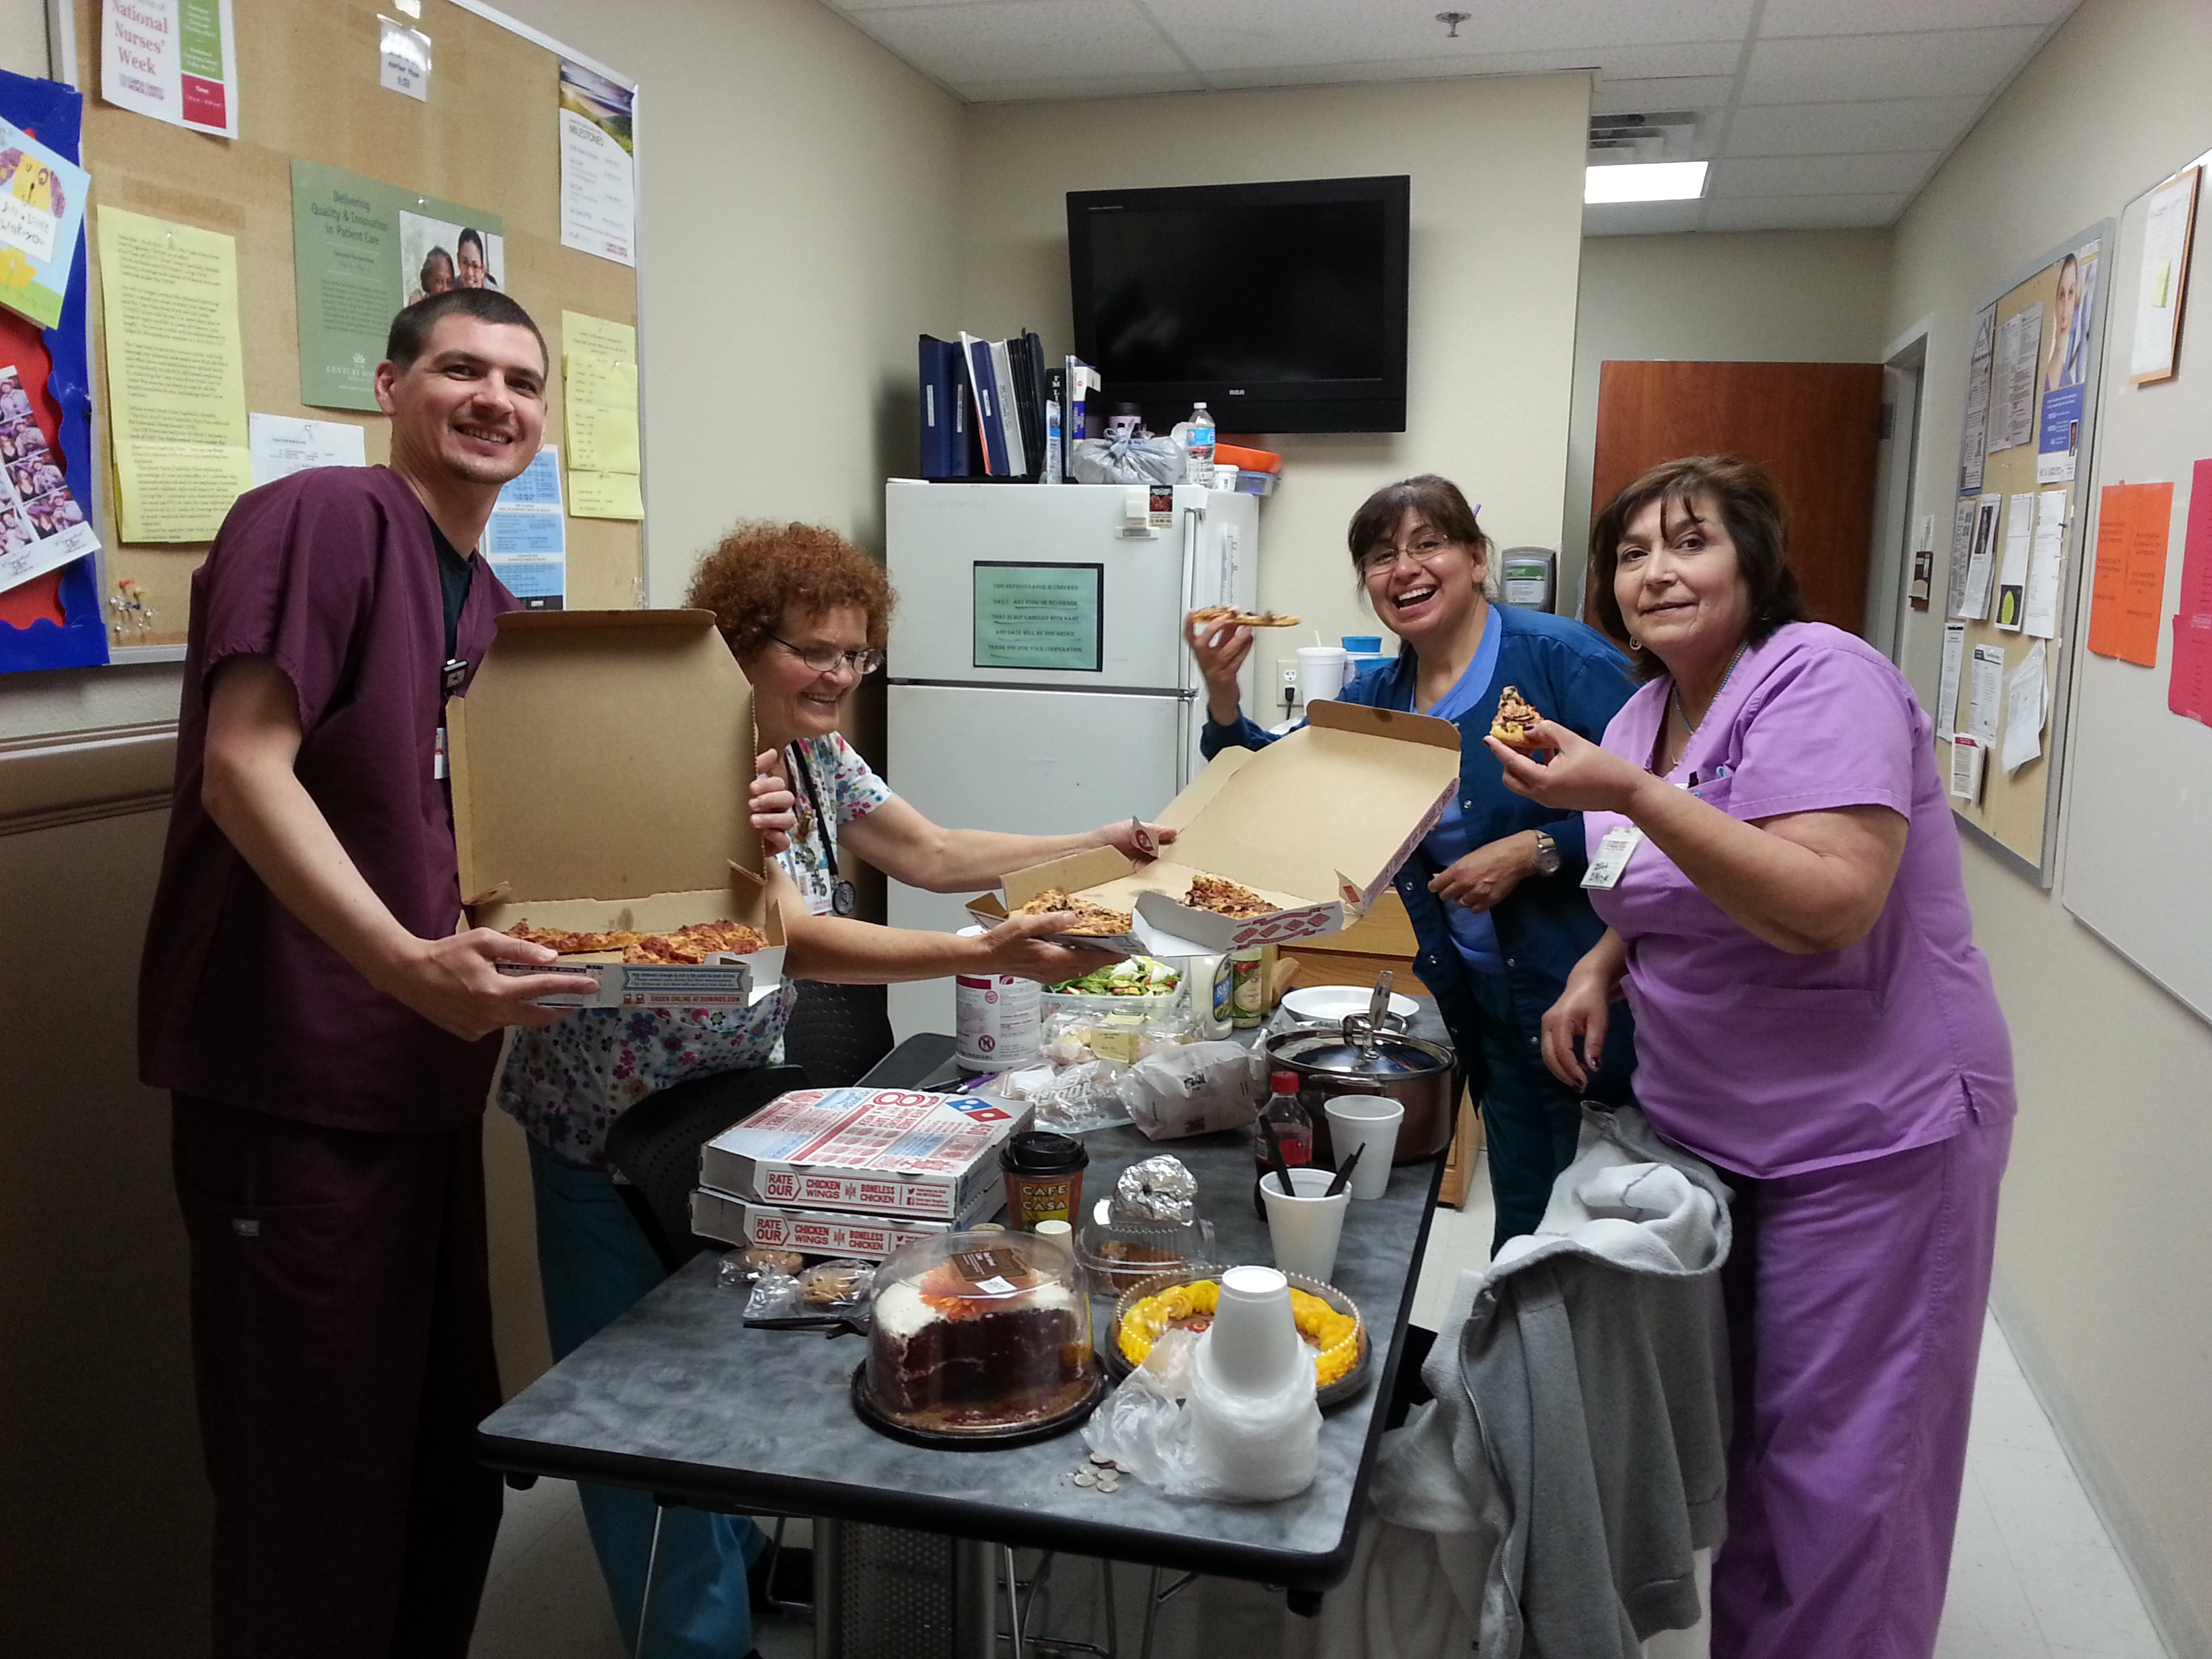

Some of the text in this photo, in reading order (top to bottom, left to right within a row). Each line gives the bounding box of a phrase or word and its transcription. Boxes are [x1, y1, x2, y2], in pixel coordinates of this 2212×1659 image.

[112, 0, 167, 33] National
[115, 21, 165, 54] Nurses'
[118, 46, 156, 75] Week
[333, 190, 370, 213] Delivering
[312, 203, 388, 231] Quality & Innovation
[325, 222, 380, 245] in Patient Care
[769, 1174, 794, 1185] RATE
[806, 1179, 841, 1190] CHICKEN
[768, 1185, 793, 1196] OUR
[806, 1189, 840, 1199] WINGS
[861, 1183, 895, 1195] BONELESS
[1022, 1185, 1067, 1195] CAFE
[860, 1193, 894, 1204] CHICKEN
[1022, 1201, 1066, 1211] CASA
[757, 1218, 781, 1230] RATE
[794, 1224, 830, 1235] CHICKEN
[756, 1229, 781, 1242] OUR
[795, 1234, 829, 1245] WINGS
[849, 1229, 884, 1242] BONELESS
[848, 1240, 883, 1250] CHICKEN
